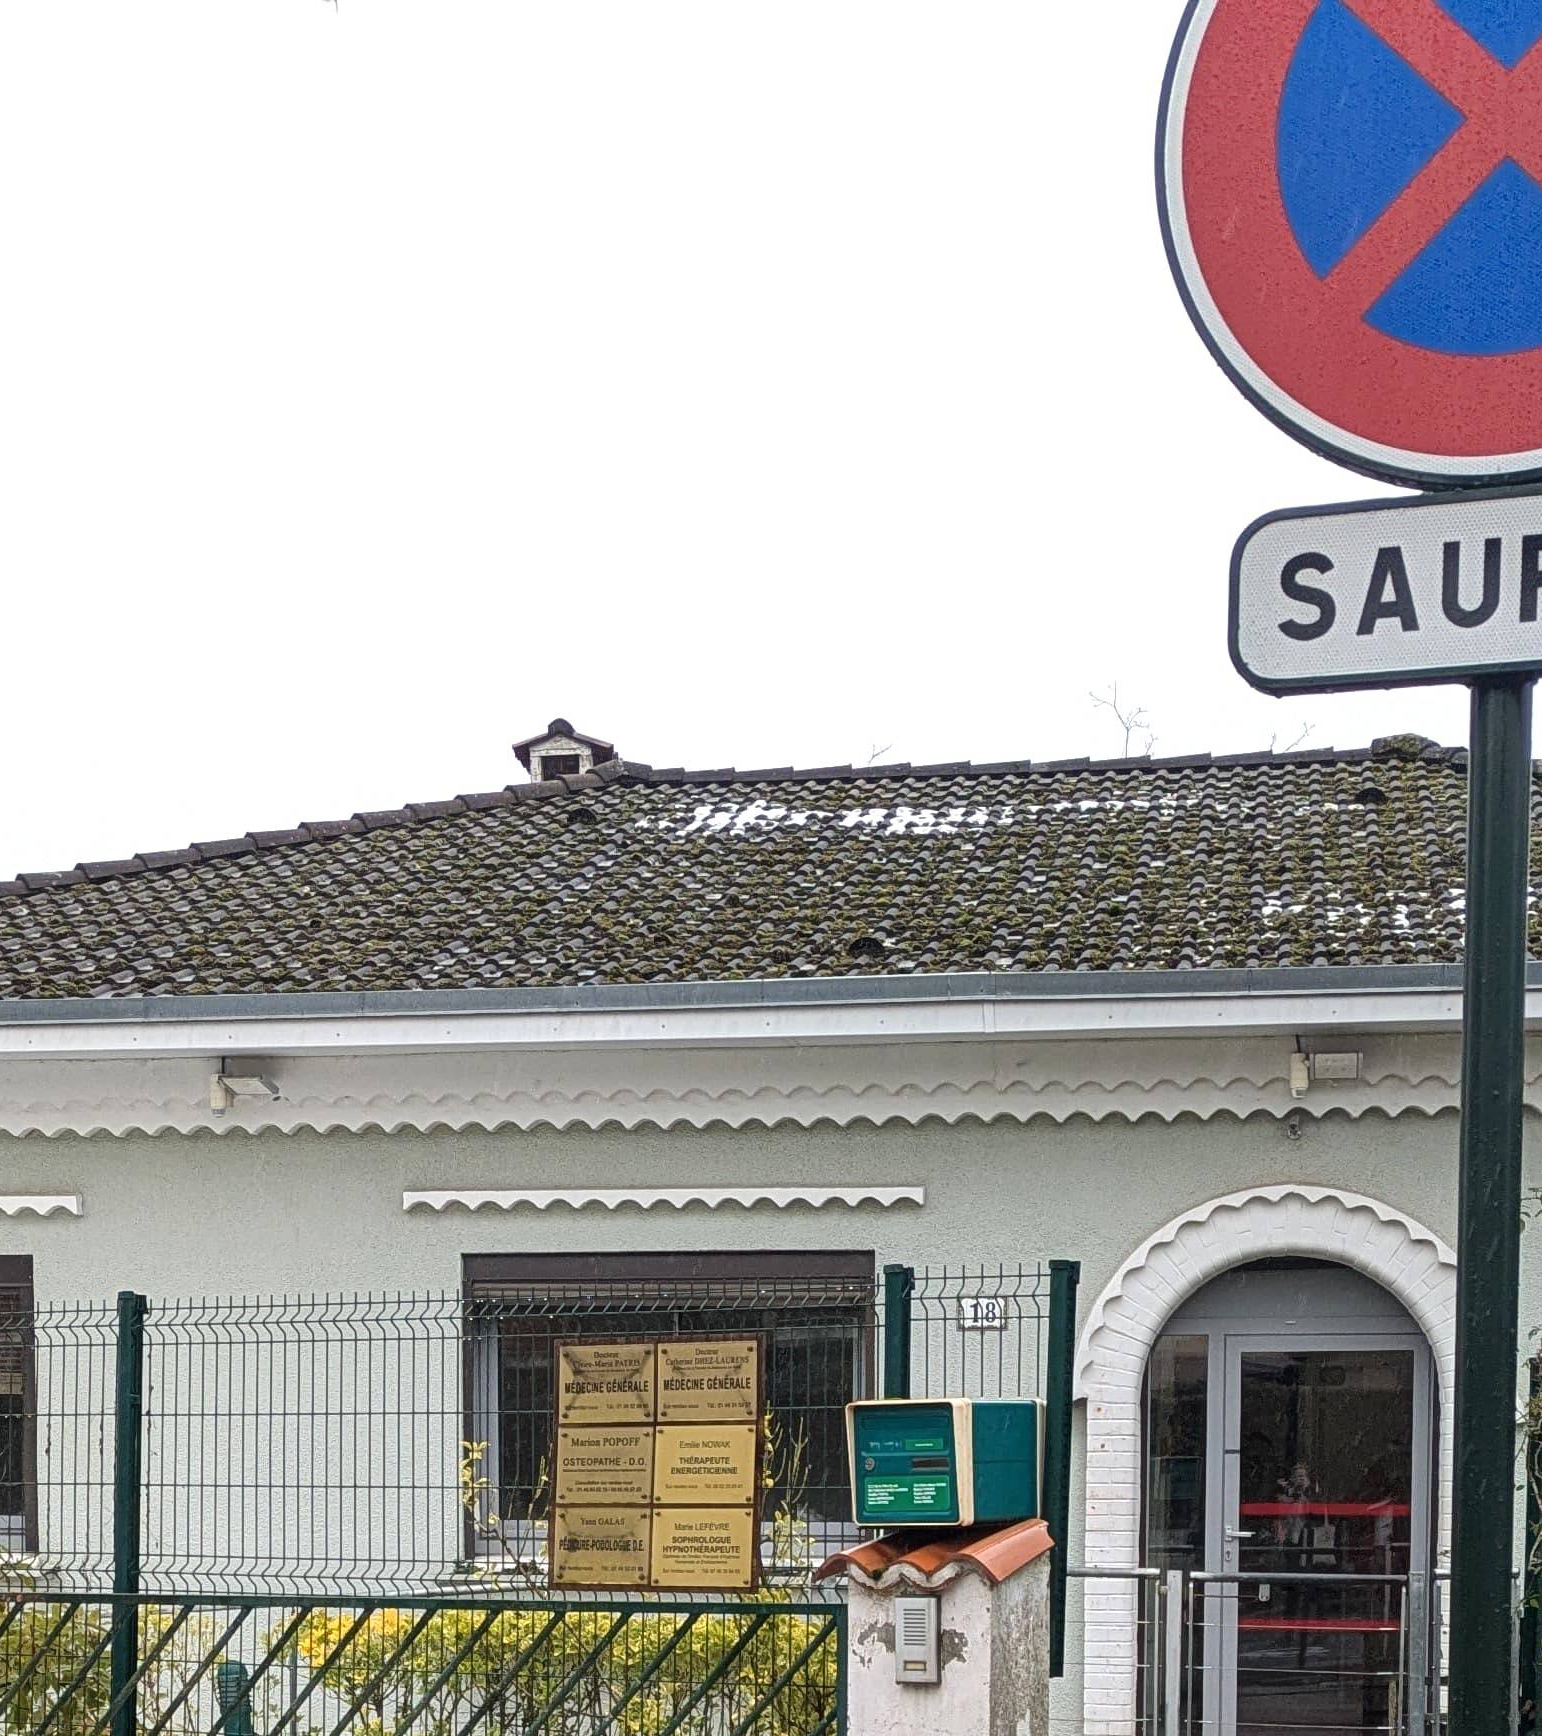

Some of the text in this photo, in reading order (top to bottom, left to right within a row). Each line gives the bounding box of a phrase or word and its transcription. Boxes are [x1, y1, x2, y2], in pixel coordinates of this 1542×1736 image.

[969, 1301, 997, 1324] 18
[593, 1351, 619, 1359] Docteur
[695, 1348, 718, 1356] Docteur
[606, 1377, 649, 1393] GÉNÉRALE
[663, 1375, 751, 1391] MÉDECINE GÉNÉRALE
[570, 1436, 641, 1447] Marion POPOFF
[701, 1440, 731, 1449] NOWAK
[580, 1517, 625, 1526] Yann GALAS
[674, 1522, 694, 1531] Marie
[558, 1536, 631, 1551] PÉURE-PODOLOGUE
[671, 1536, 732, 1544] SOPHROLOGUE
